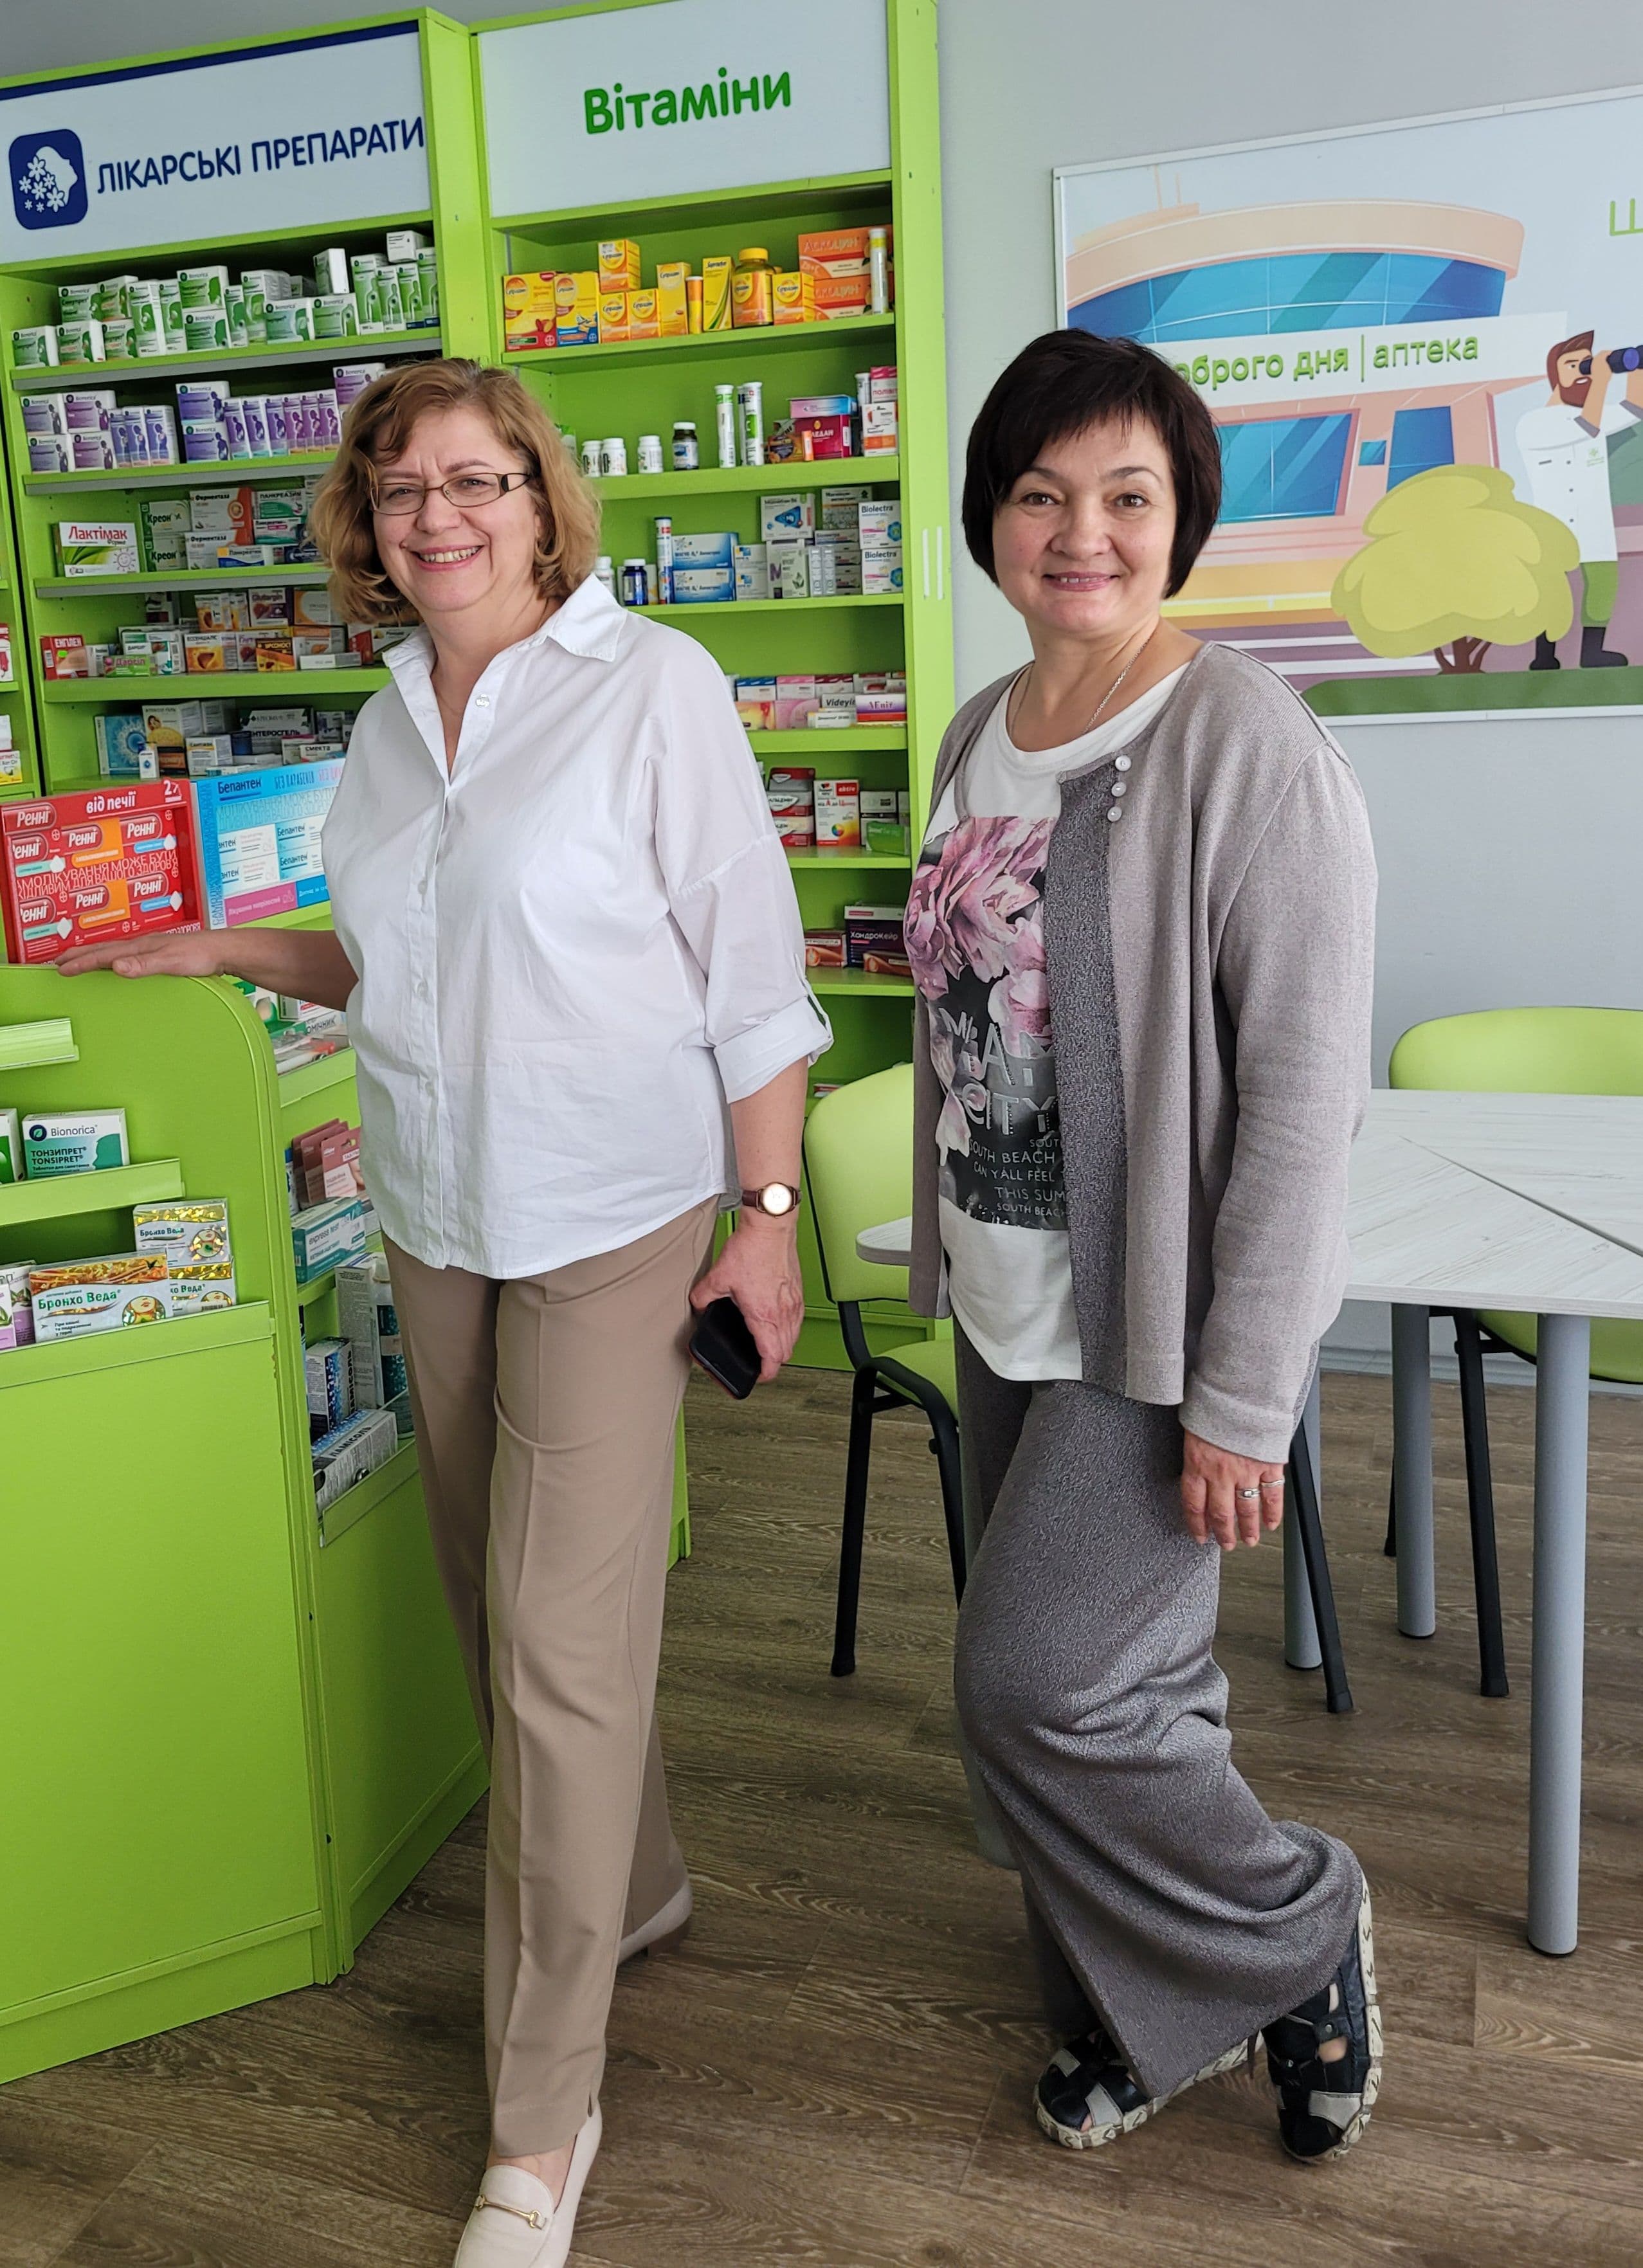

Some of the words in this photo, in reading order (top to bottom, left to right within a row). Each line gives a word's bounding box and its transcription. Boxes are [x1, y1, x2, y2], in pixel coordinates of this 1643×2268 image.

[584, 66, 791, 134] Вітаміни
[97, 145, 241, 194] ЛІКАРСЬКІ
[251, 116, 424, 173] ПРЕПАРАТИ
[1175, 354, 1284, 391] оброго
[1293, 346, 1349, 381] дня
[1372, 335, 1478, 369] аптека
[861, 504, 893, 514] Biolectra
[68, 525, 128, 540] Лактімак
[864, 550, 896, 559] Biolectra
[217, 776, 262, 795] Бепантен
[86, 797, 104, 814] від
[107, 791, 137, 810] печії
[17, 810, 50, 827] Ренні
[127, 818, 157, 839] Ренні
[277, 823, 306, 837] Бепантен
[68, 829, 98, 848] Ренні
[218, 837, 237, 849] антен
[280, 852, 309, 866] Бепантен
[17, 862, 109, 890] АМОЛІКУВАННЯ
[111, 854, 147, 869] МОЖЕ
[149, 849, 177, 864] БУТИ
[72, 876, 94, 889] ДЛЯ
[96, 868, 134, 883] ВАШОГО
[221, 867, 240, 879] антен
[133, 876, 163, 898] Ренні
[75, 889, 105, 909] Ренні
[962, 1082, 1058, 1134] CITY
[51, 1125, 98, 1137] Bionorica
[969, 1138, 996, 1163] SOUTH
[1001, 1150, 1055, 1165] BEACH
[1029, 1138, 1060, 1148] SOUT
[974, 1161, 988, 1178] CAN
[1028, 1170, 1055, 1183] FEEL
[994, 1186, 1030, 1201] THIS
[997, 1202, 1031, 1213] SOUTH
[38, 1294, 84, 1311] Бронхо
[86, 1290, 118, 1303] Веда
